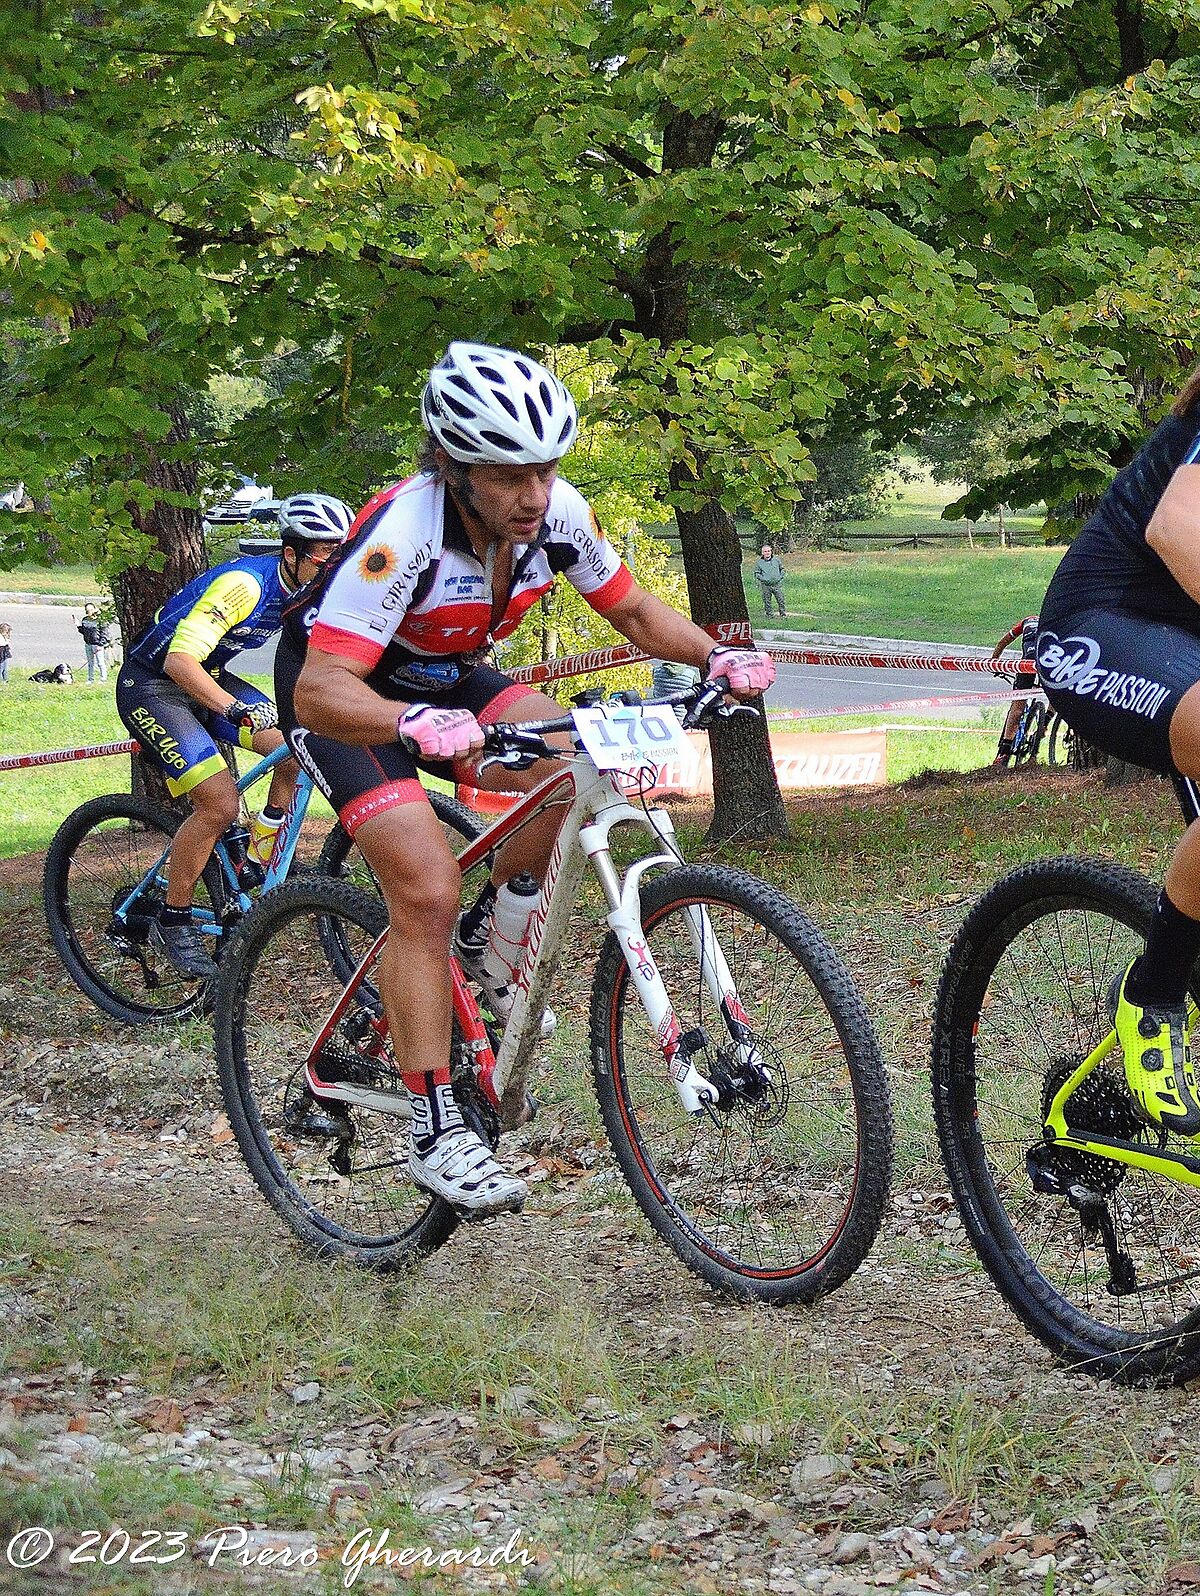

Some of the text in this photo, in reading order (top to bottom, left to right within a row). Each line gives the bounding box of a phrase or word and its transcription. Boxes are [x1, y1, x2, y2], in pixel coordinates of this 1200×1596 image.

[552, 518, 569, 536] IL
[369, 617, 389, 634] IL
[1039, 643, 1171, 719] BIKE PASSION
[132, 707, 167, 741] BAR
[590, 716, 673, 748] 170
